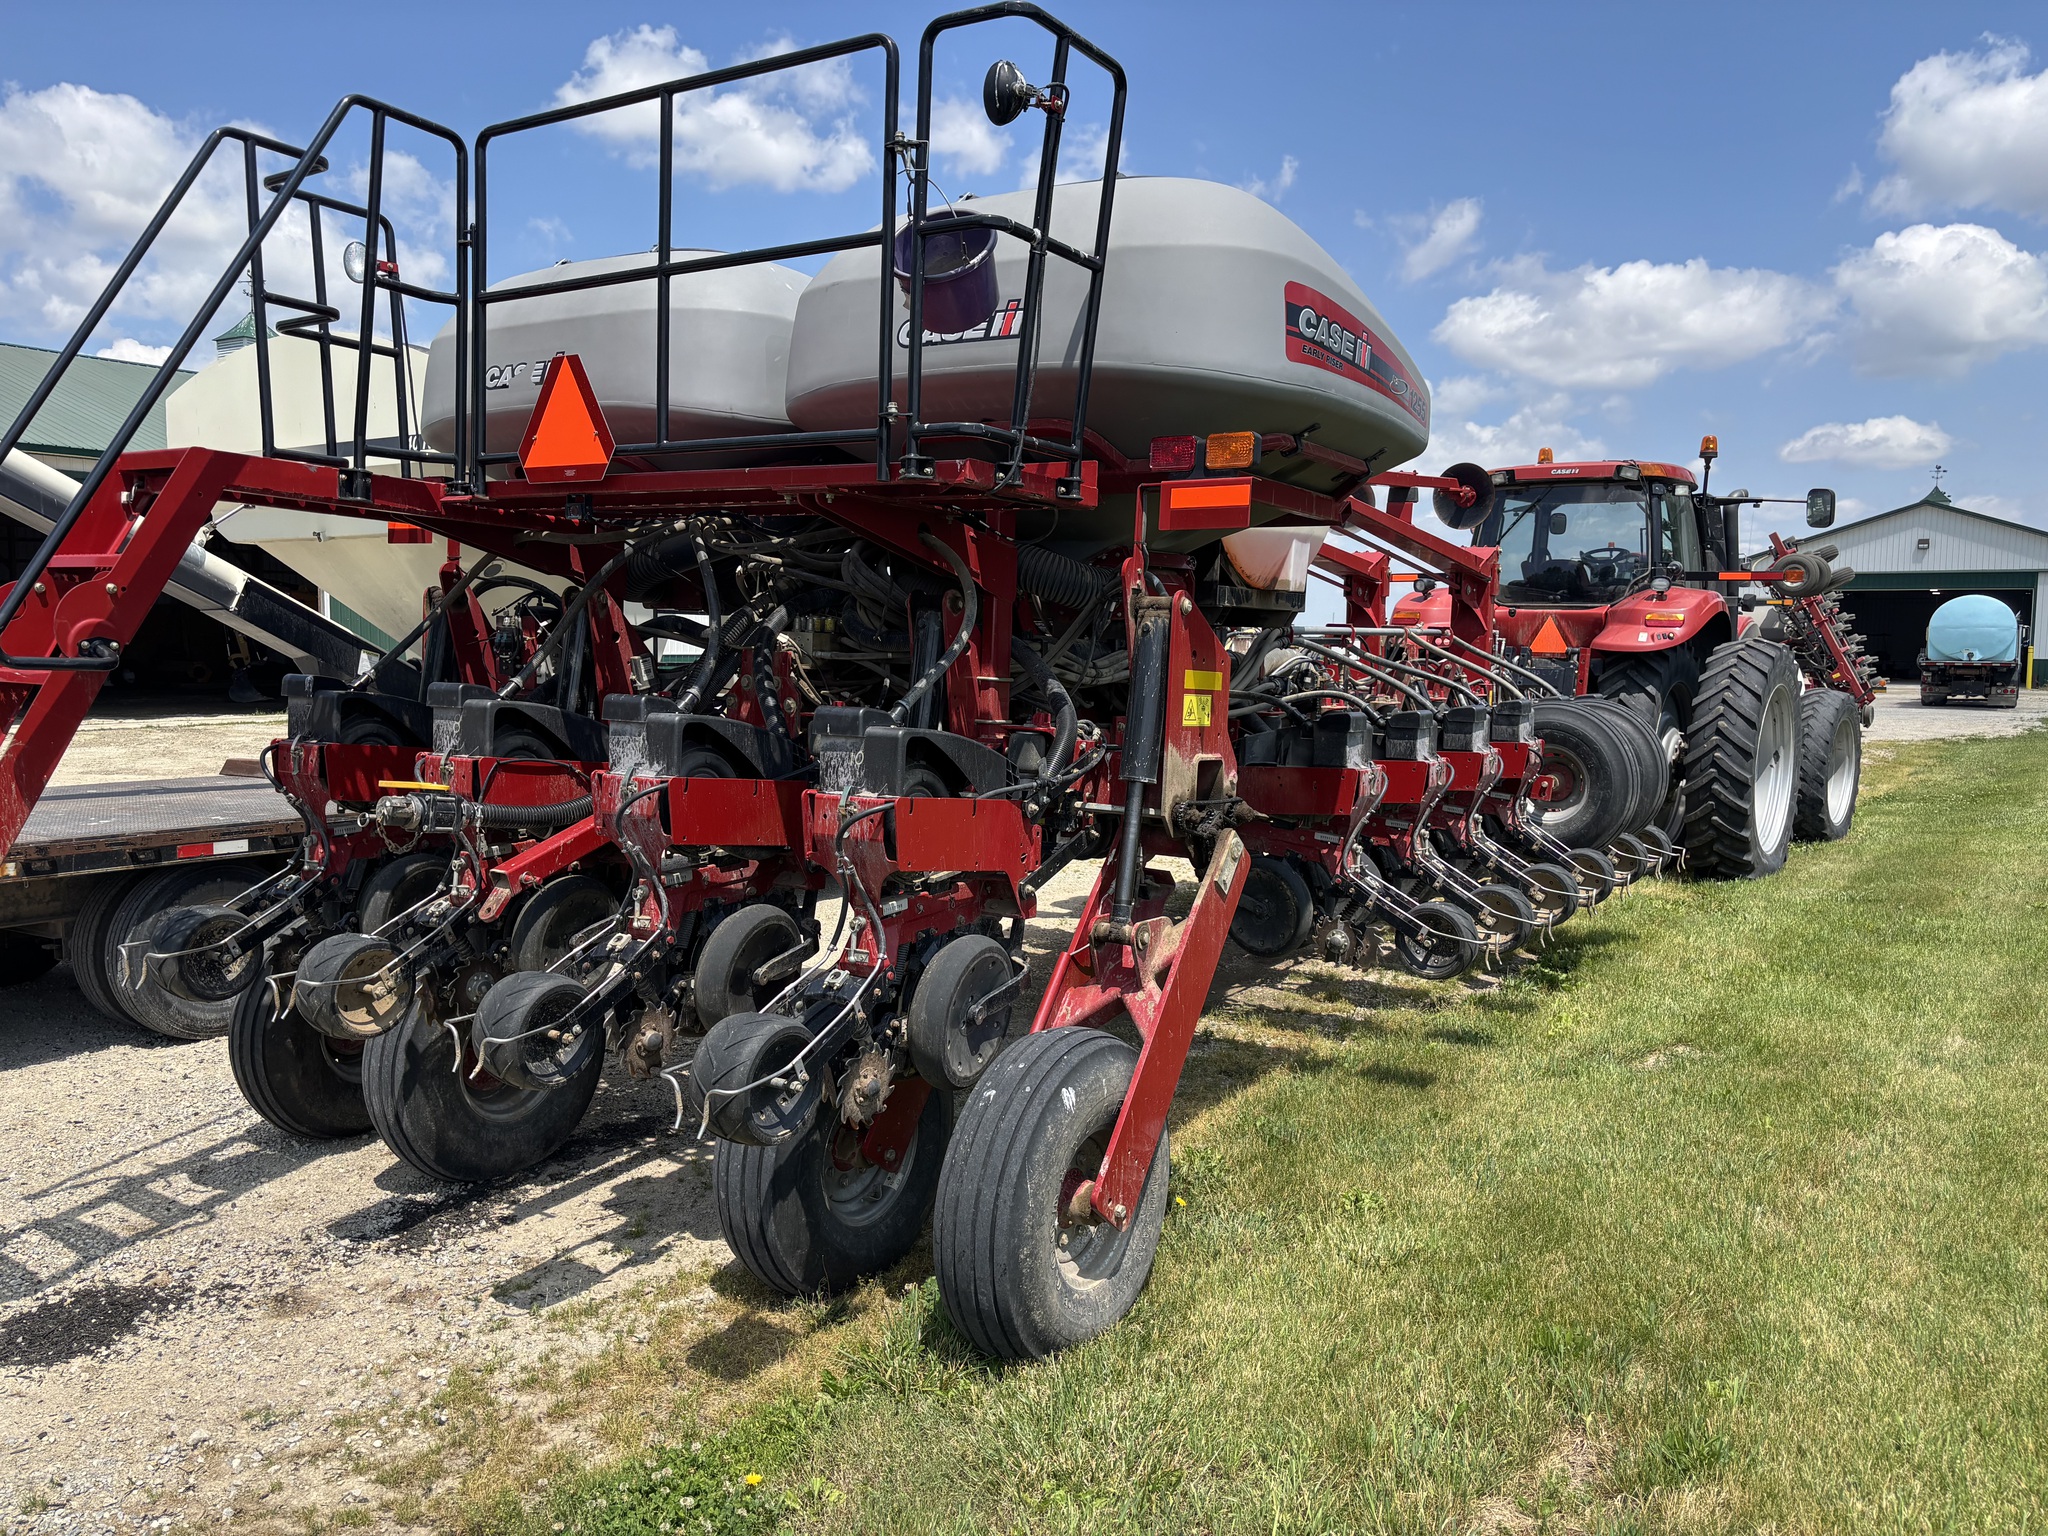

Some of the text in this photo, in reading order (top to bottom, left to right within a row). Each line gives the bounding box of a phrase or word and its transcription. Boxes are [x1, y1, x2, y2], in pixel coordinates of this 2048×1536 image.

[1298, 307, 1355, 361] CASE
[1302, 344, 1344, 371] EARLY RISER
[1409, 388, 1426, 422] 1255
